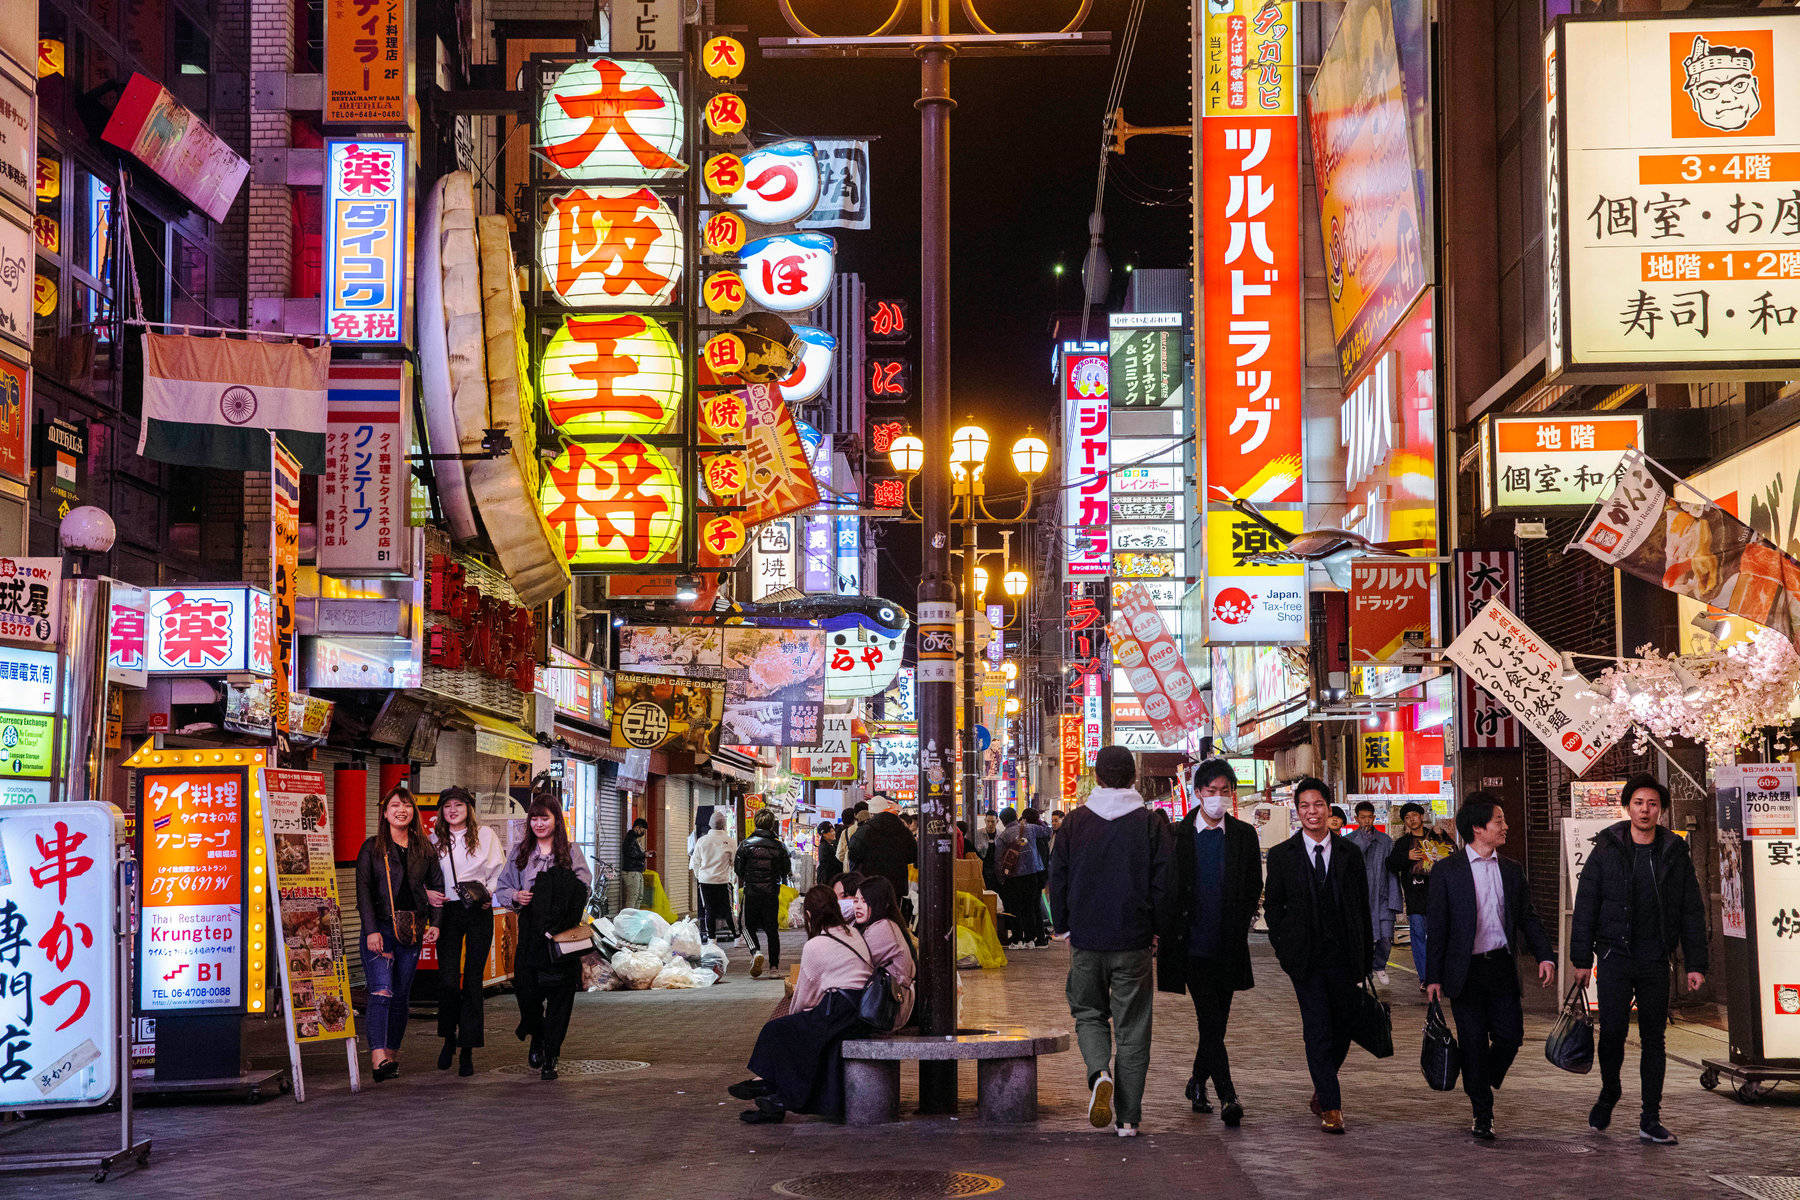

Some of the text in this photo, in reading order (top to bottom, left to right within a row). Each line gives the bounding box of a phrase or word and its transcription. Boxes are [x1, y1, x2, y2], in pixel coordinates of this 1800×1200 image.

[1210, 36, 1222, 74] 当ビル
[1231, 19, 1244, 106] なんば道頓堀店
[384, 69, 399, 79] 2F
[344, 148, 395, 194] 薬
[342, 204, 388, 307] ダイコク
[1224, 128, 1280, 455] ツルハドラッグ
[331, 314, 397, 339] 免税
[1619, 289, 1799, 340] 寿司・和
[1125, 344, 1139, 405] &コミック
[1141, 331, 1157, 405] インターネット
[1536, 425, 1596, 449] 地階
[338, 432, 350, 546] タイカルチャースクール
[353, 425, 374, 530] クンテープ
[378, 432, 391, 547] タイ料理とタイスキの店
[1079, 404, 1109, 560] ジャンカラ
[1120, 480, 1169, 490] レインボー
[1355, 567, 1428, 591] ツルハ
[1263, 601, 1302, 611] Tax-free
[1266, 590, 1302, 600] Japan.
[1355, 595, 1414, 612] ドラッグ
[1134, 617, 1157, 633] CAFE
[1277, 612, 1303, 623] Shop
[164, 602, 228, 663] 薬
[1488, 607, 1558, 672] 期間限定セール
[1149, 646, 1174, 664] INFO
[1482, 630, 1564, 702] しゃぶしゃぶ
[617, 674, 724, 690] MAMESHIBA CAFE OSAKA
[1167, 675, 1189, 691] LIVE
[1147, 697, 1166, 711] LIVE
[24, 717, 47, 728] Exchange
[1124, 732, 1162, 745] ZAZ
[1366, 736, 1390, 768] 薬
[832, 761, 850, 773] 2F
[148, 781, 237, 812] タイ料理
[1745, 791, 1791, 802] 飲み放題
[181, 812, 238, 825] タイスキの店
[1767, 840, 1800, 866] 宴
[29, 821, 95, 1033] 串かつ
[178, 913, 232, 924] Restaurant
[151, 925, 233, 943] Krungtep
[197, 963, 223, 982] B1
[152, 989, 169, 999] TEL
